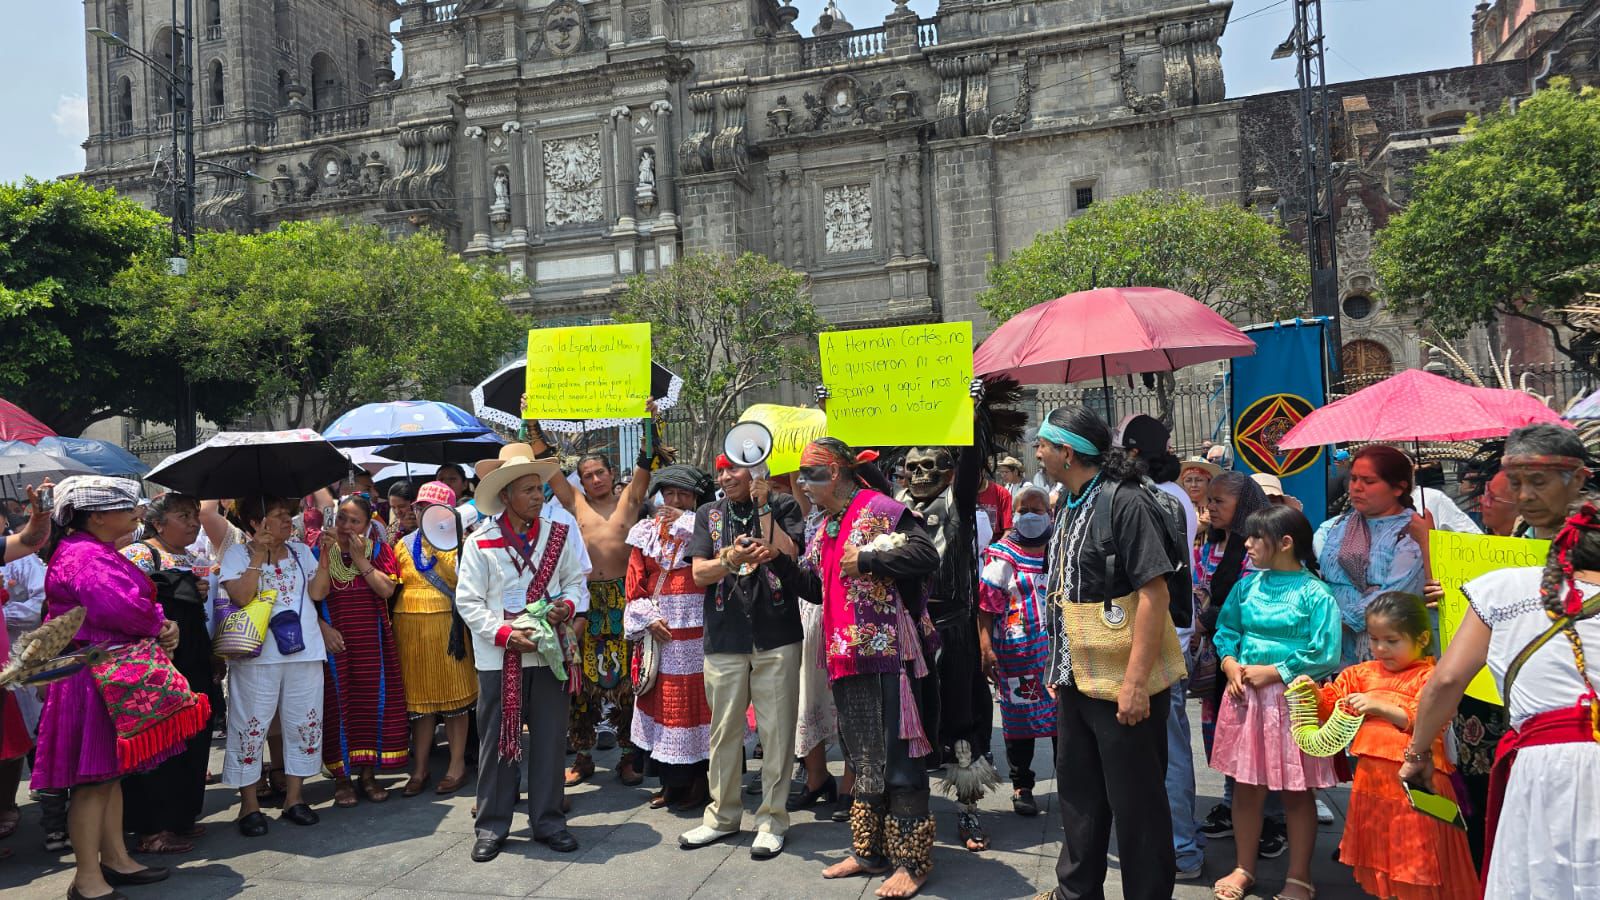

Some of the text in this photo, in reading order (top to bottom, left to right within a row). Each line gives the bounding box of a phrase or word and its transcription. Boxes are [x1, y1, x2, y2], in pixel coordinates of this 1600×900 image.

[826, 336, 835, 355] A
[845, 332, 896, 353] Hernán
[949, 331, 966, 345] no
[828, 353, 953, 380] lo quisieron ni en
[883, 383, 891, 401] y
[898, 376, 922, 396] aquí
[931, 376, 952, 389] nos
[960, 369, 970, 386] lo
[890, 403, 898, 414] a
[906, 395, 943, 413] votar
[1449, 534, 1475, 563] Para
[1479, 538, 1538, 568] Cuando
[1450, 595, 1461, 614] el
